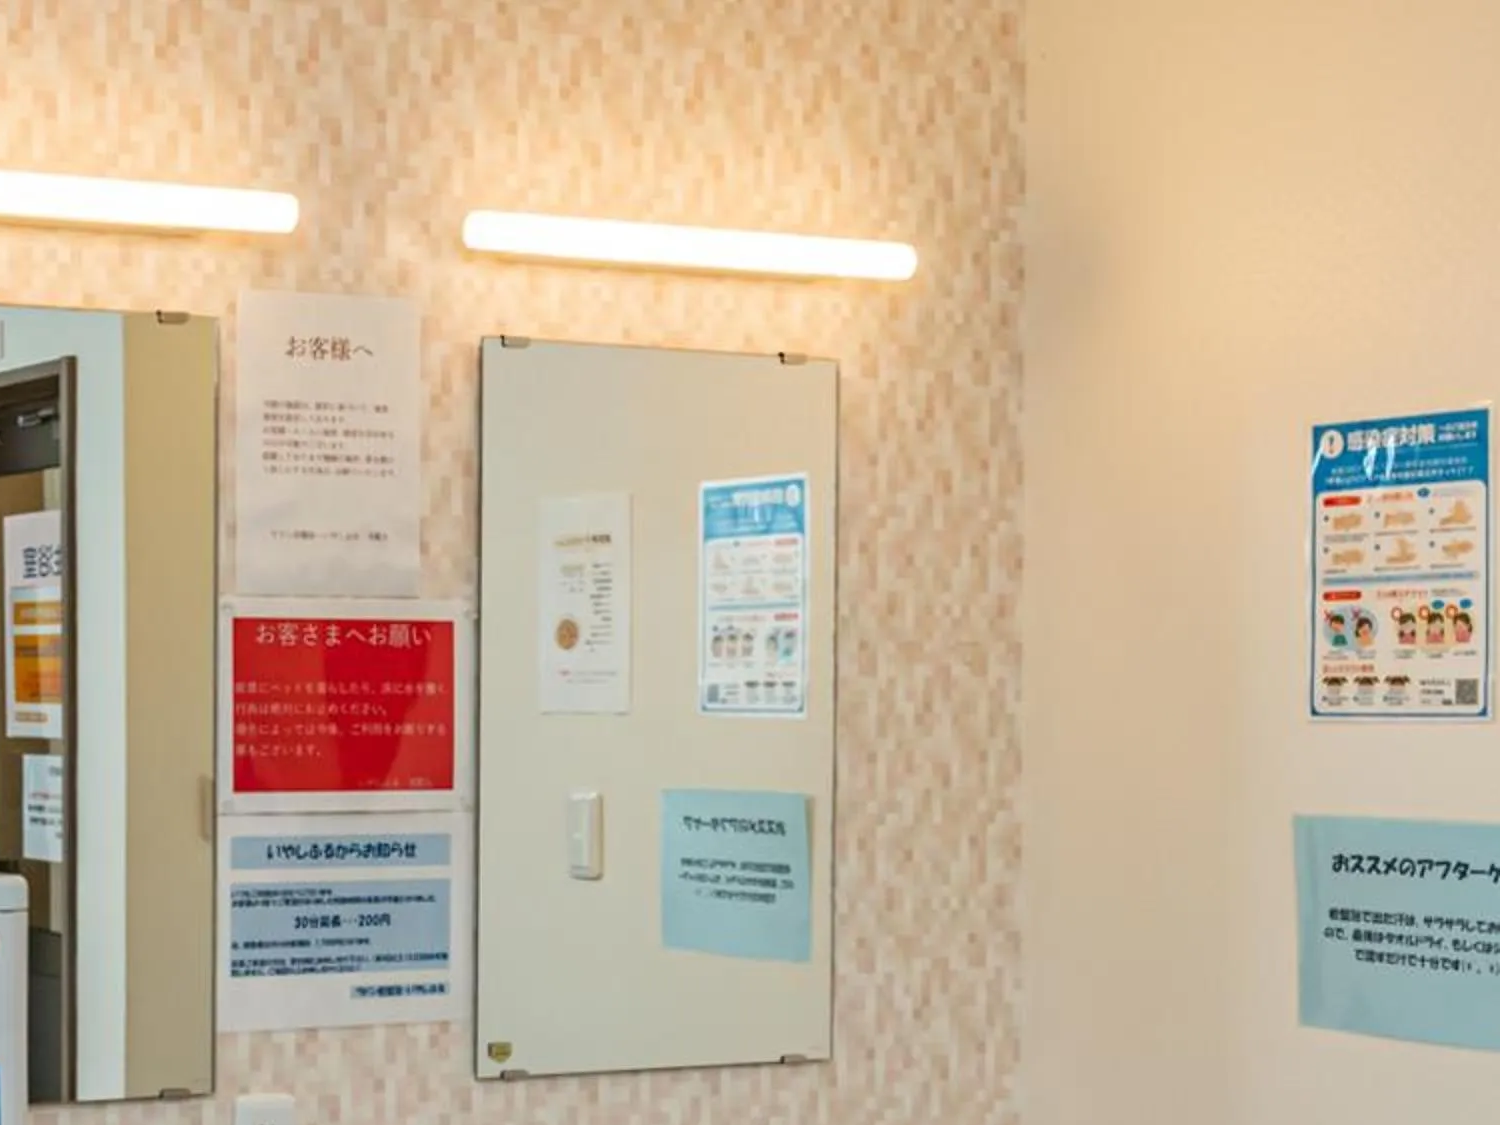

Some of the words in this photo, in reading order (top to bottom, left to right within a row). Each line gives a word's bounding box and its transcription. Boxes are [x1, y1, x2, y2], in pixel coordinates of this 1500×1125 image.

[284, 335, 374, 361] お客様へ
[255, 622, 432, 648] お客さまへお願い
[266, 841, 417, 861] いやしふるからお知らせ
